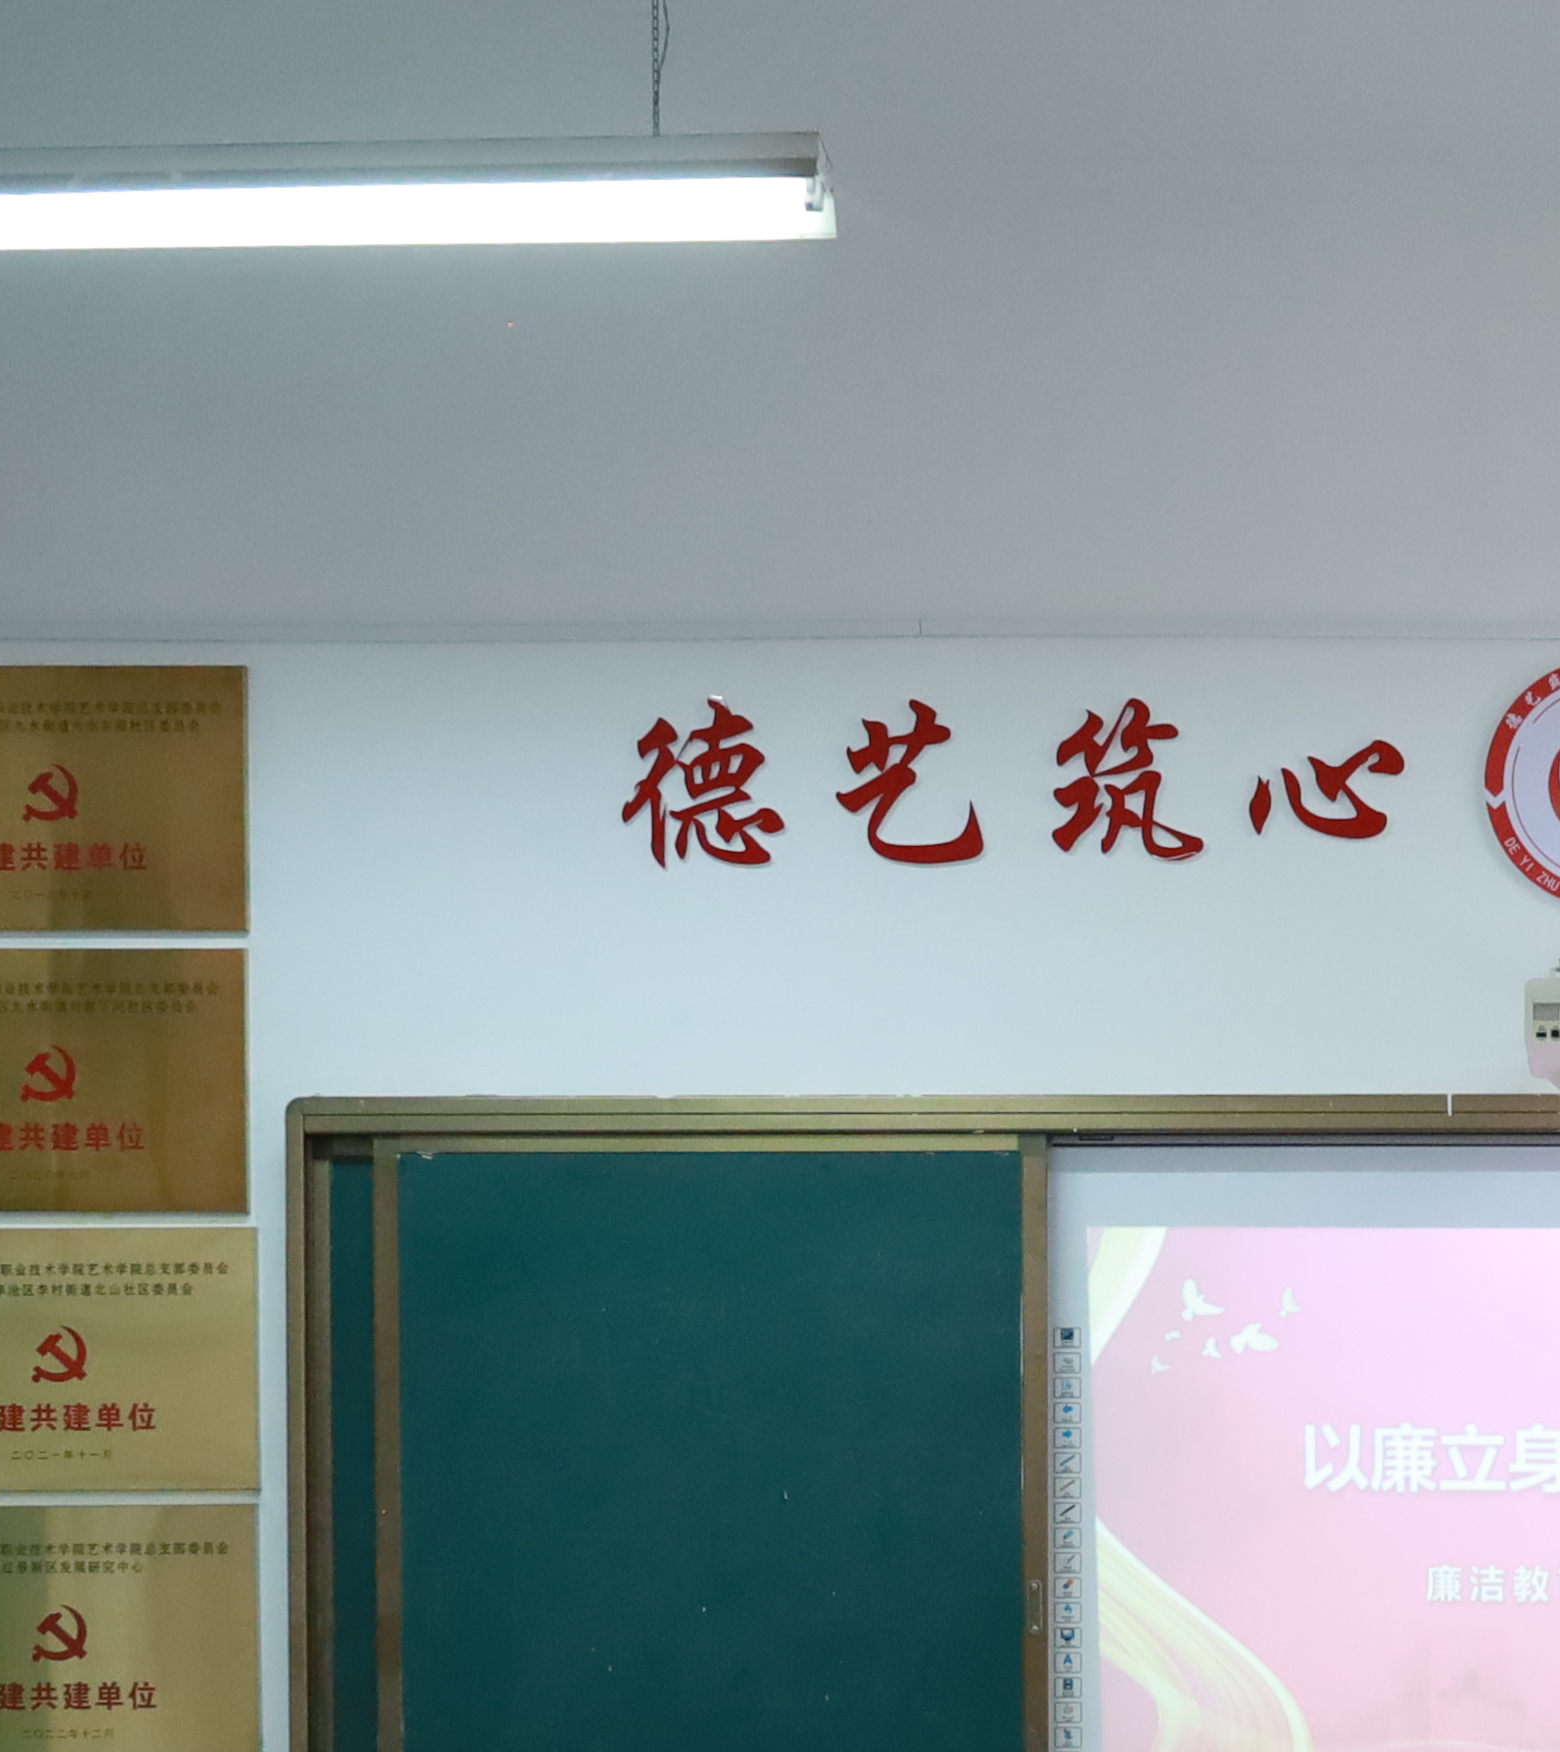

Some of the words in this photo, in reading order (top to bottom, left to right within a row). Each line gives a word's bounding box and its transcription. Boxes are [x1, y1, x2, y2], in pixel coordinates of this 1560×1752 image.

[622, 698, 1406, 868] 德艺筑心
[1504, 836, 1519, 856] DE
[1519, 855, 1533, 872] YI
[1536, 871, 1560, 891] ZHU
